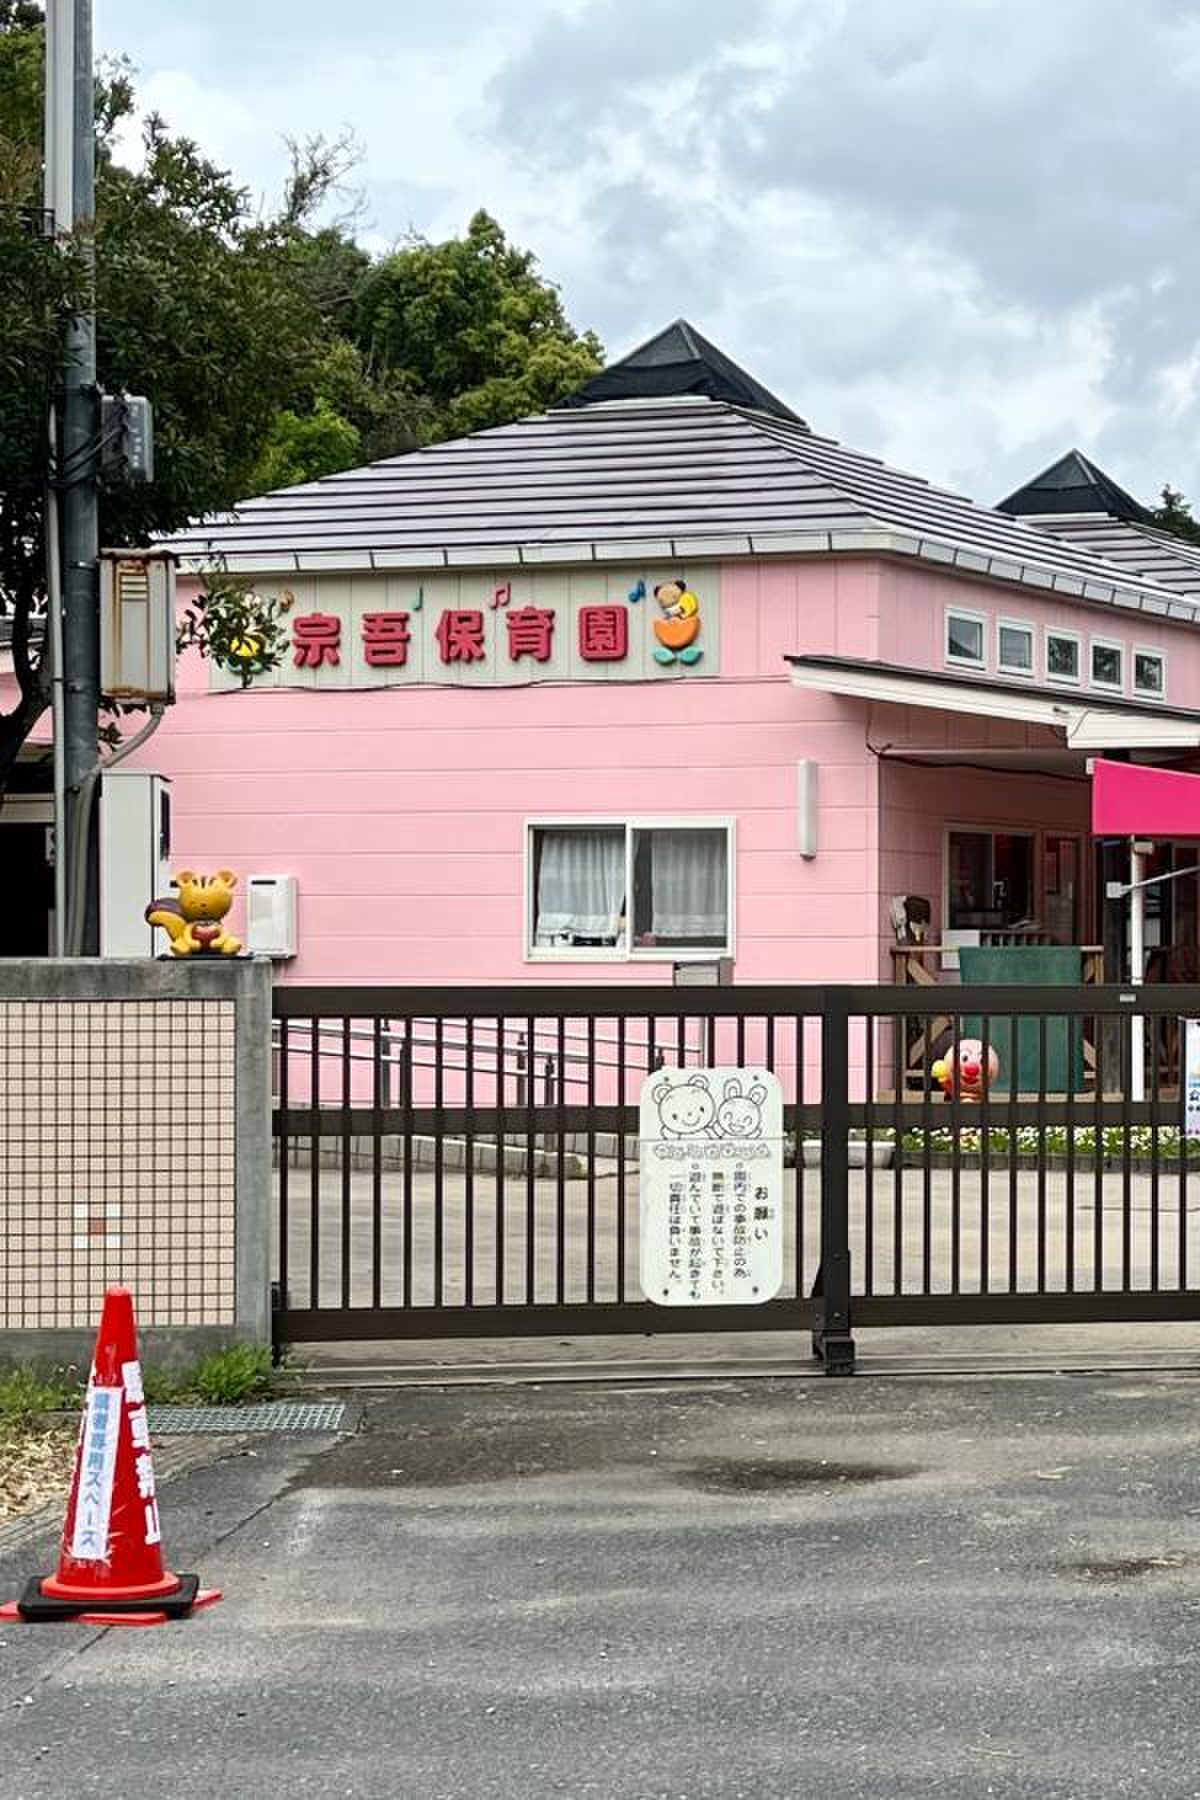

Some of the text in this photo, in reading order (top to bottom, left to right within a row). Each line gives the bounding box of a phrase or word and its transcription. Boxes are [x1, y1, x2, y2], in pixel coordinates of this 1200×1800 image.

[292, 605, 630, 668] 宗吾保育園
[754, 1186, 769, 1241] お願い
